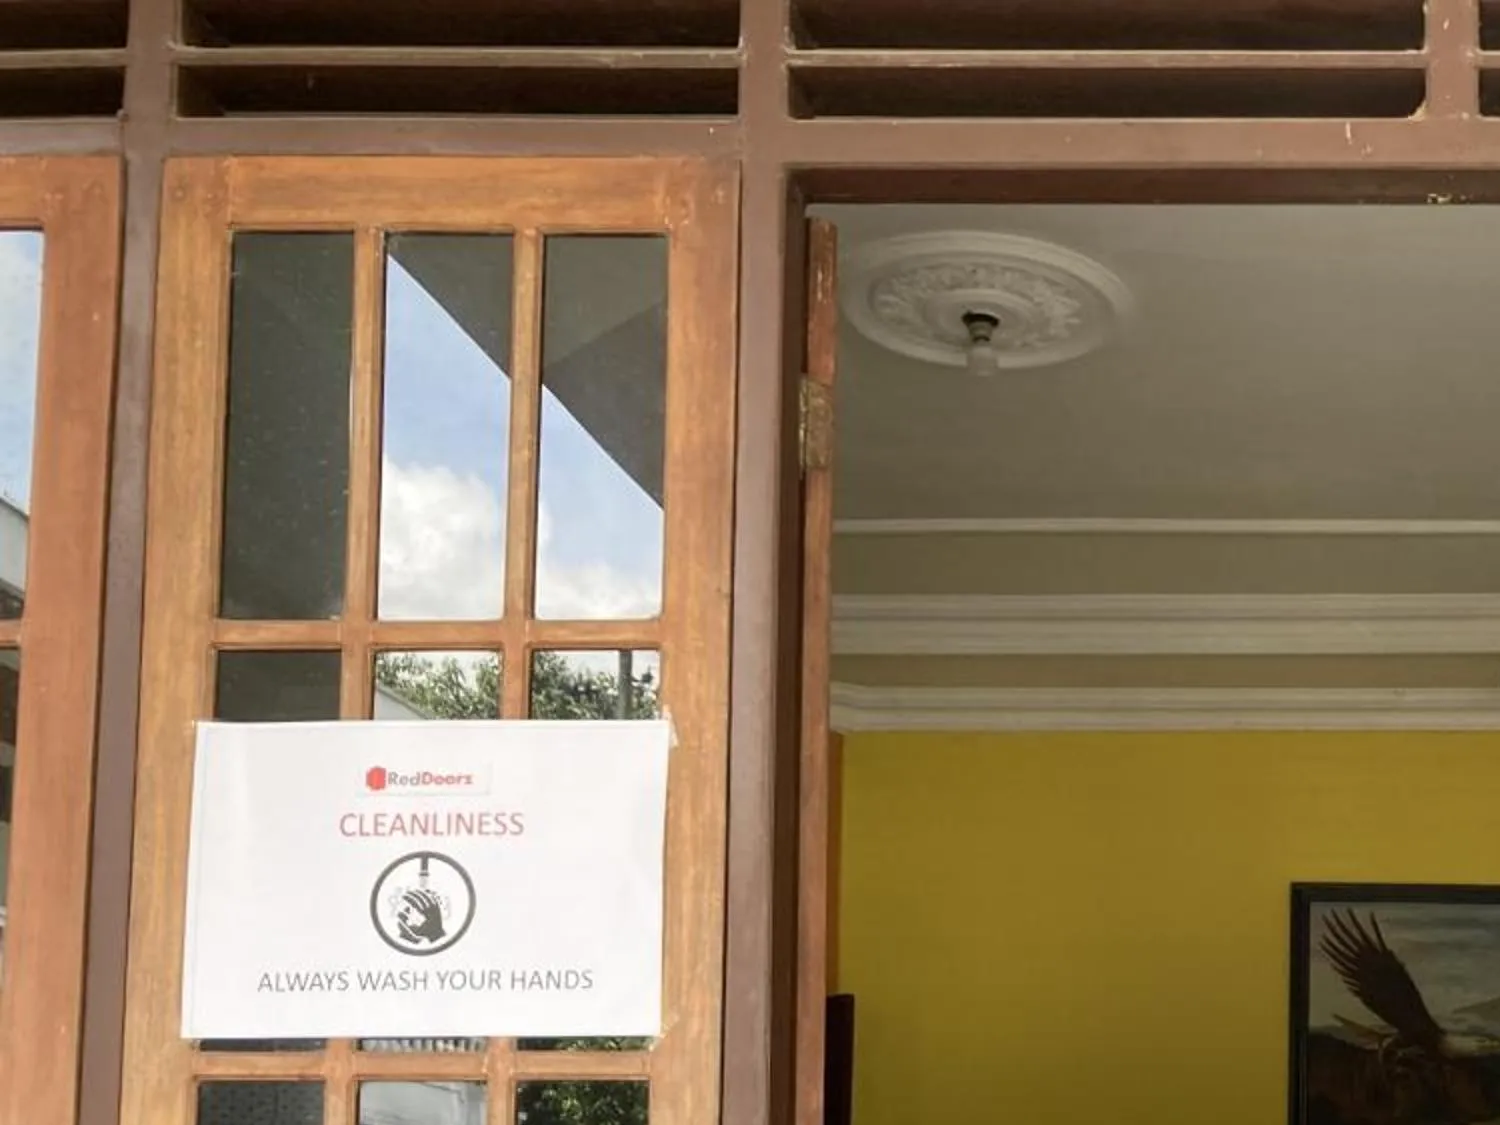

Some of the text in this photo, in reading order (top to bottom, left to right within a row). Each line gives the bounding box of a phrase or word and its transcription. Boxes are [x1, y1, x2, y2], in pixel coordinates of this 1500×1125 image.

[339, 811, 525, 839] CLEANLINESS
[257, 969, 594, 993] ALWAYS WASH YOUR HANDS
